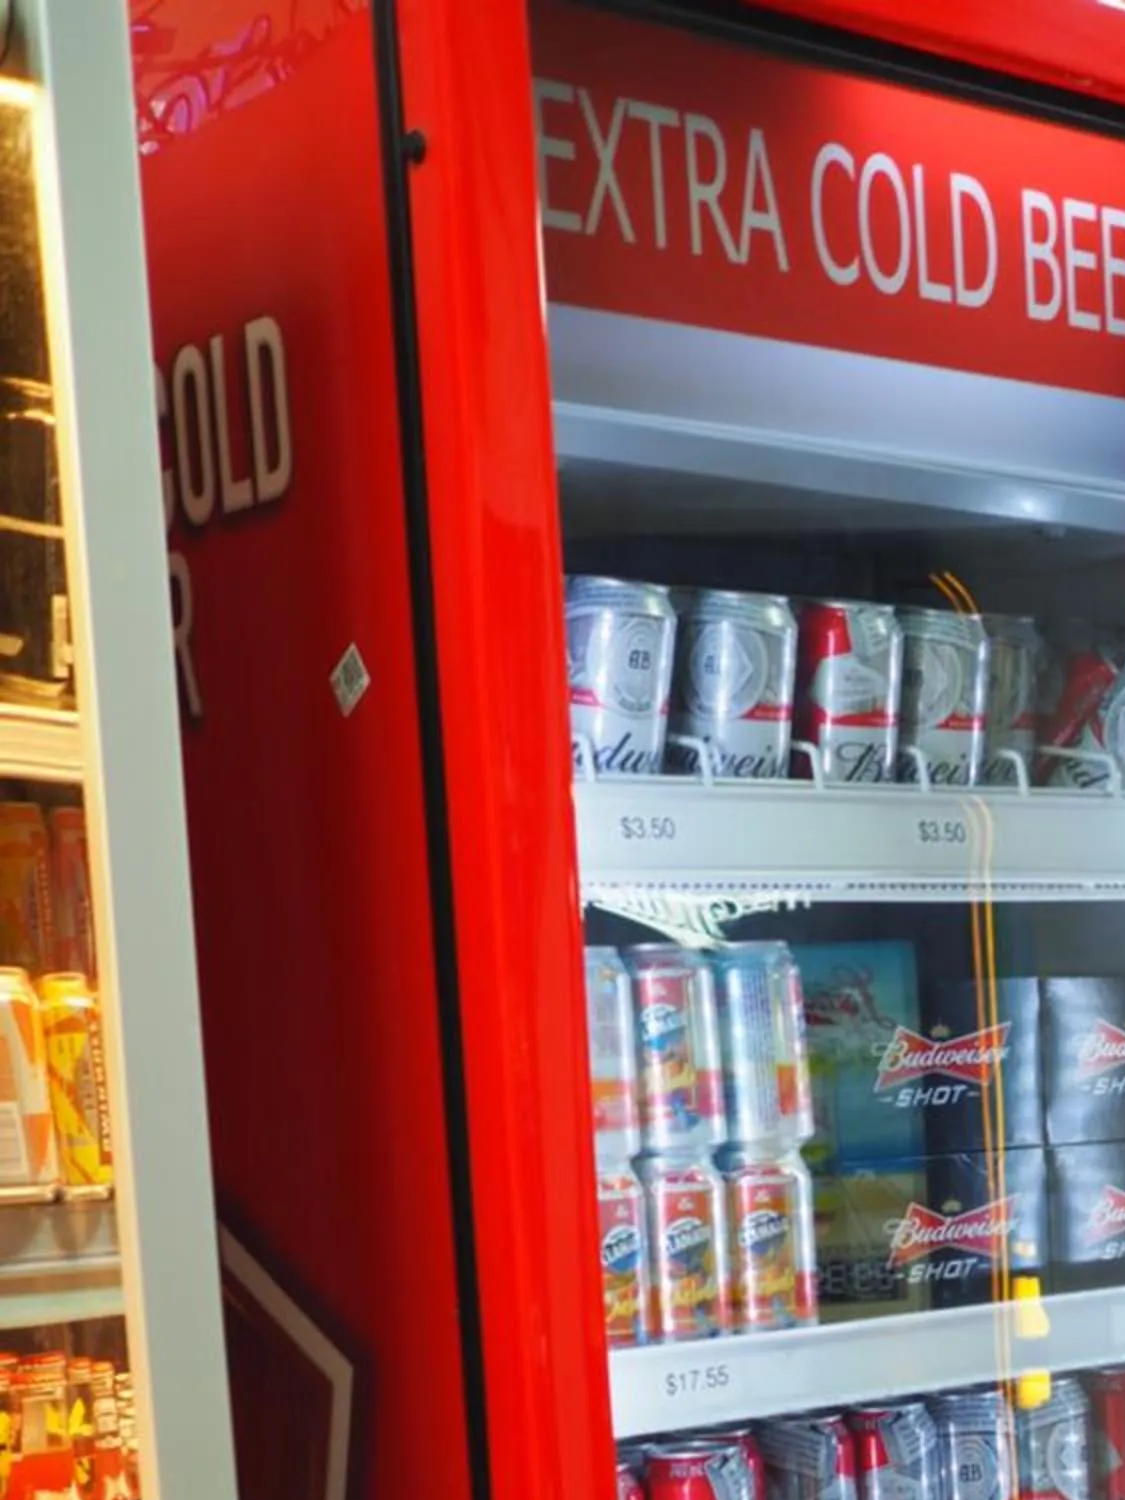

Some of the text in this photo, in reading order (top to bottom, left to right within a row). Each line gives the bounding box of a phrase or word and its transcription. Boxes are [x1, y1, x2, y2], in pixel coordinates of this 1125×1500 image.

[533, 79, 789, 272] EXTRA
[810, 142, 997, 308] COLD
[620, 816, 676, 840] $3.50
[917, 820, 967, 843] $3.50
[871, 1040, 1011, 1074] Budweiser
[884, 1214, 1018, 1249] Budweiser
[665, 1364, 731, 1396] $17.55
